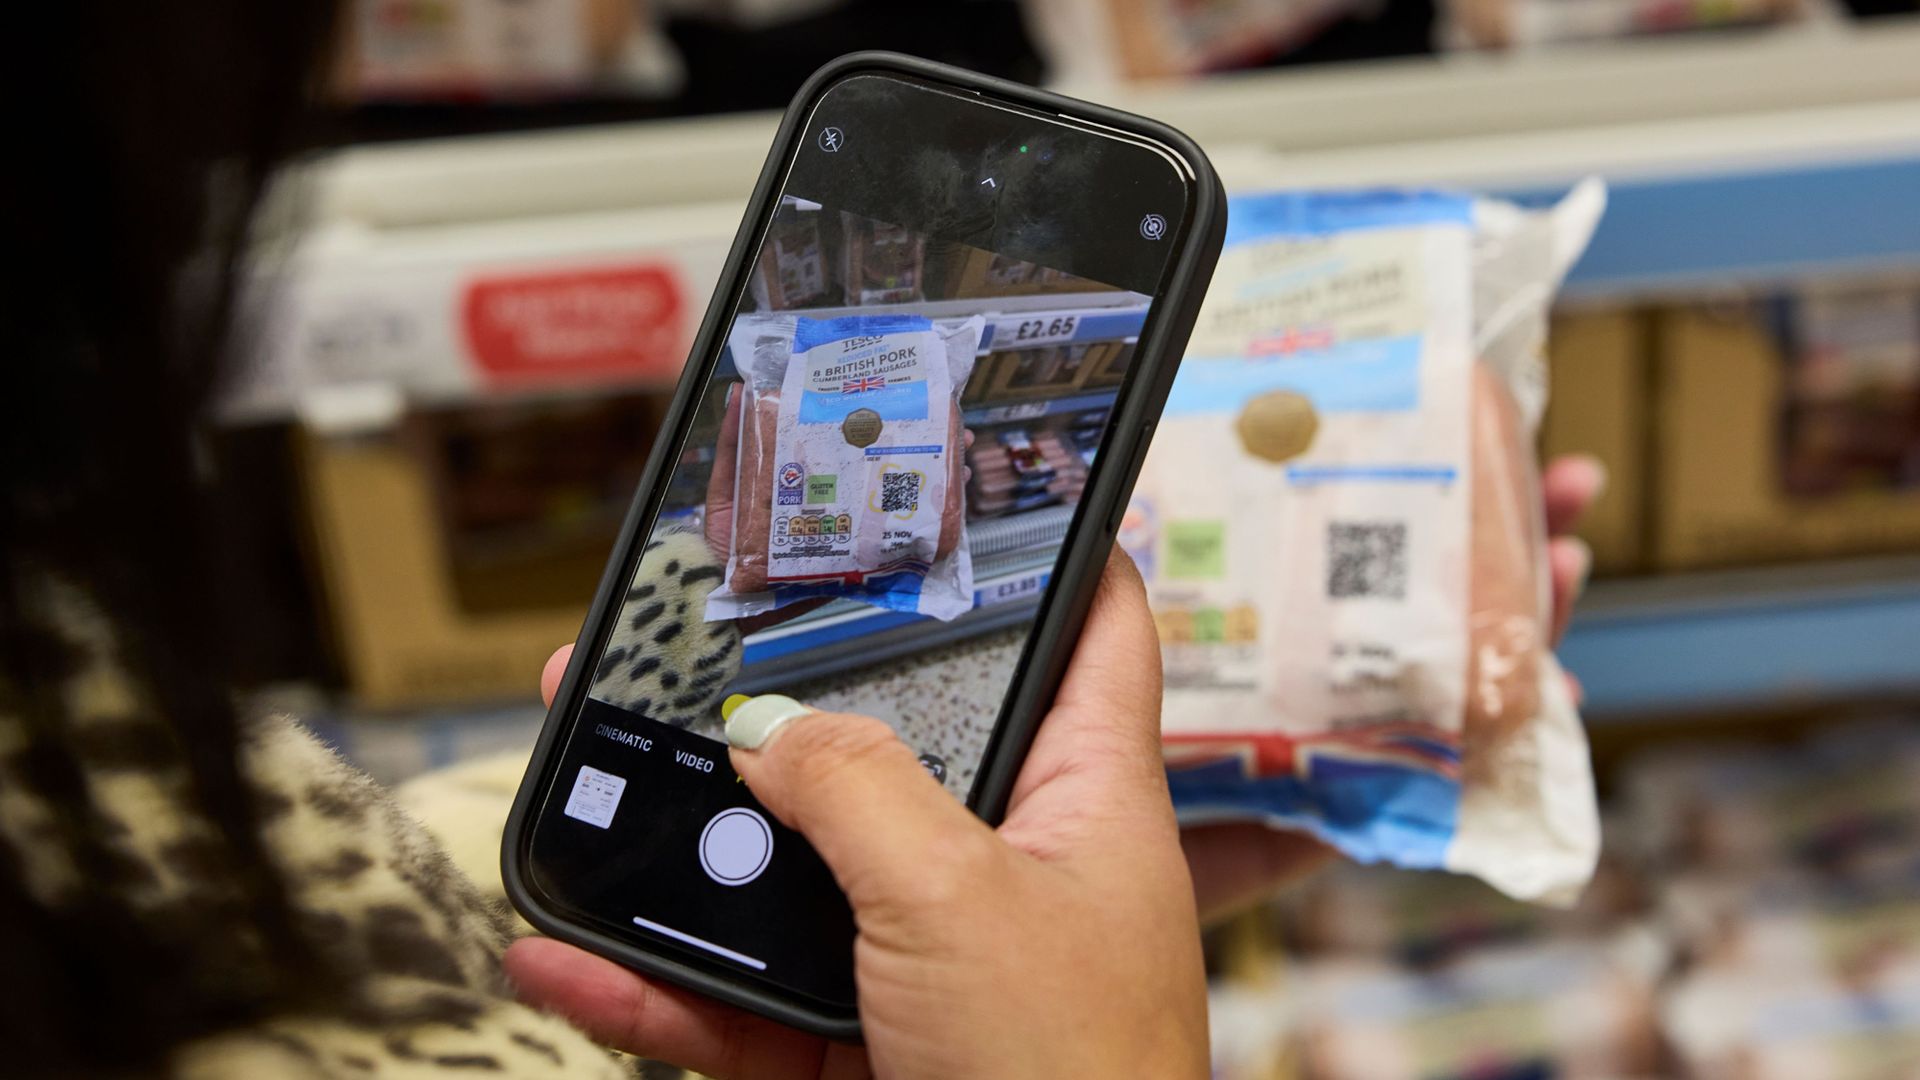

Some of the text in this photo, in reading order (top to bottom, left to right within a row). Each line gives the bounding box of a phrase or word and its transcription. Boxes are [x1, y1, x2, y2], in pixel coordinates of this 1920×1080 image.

[1017, 317, 1075, 340] £2.65
[842, 334, 884, 349] TESCO
[812, 359, 917, 383] CUMBERLAND SAUSAGES
[825, 358, 875, 377] BRITISH
[879, 346, 917, 365] PORK
[778, 496, 802, 505] PORK
[894, 530, 913, 539] NOV
[595, 723, 653, 752] CINEMATIC
[675, 750, 714, 773] VIDEO
